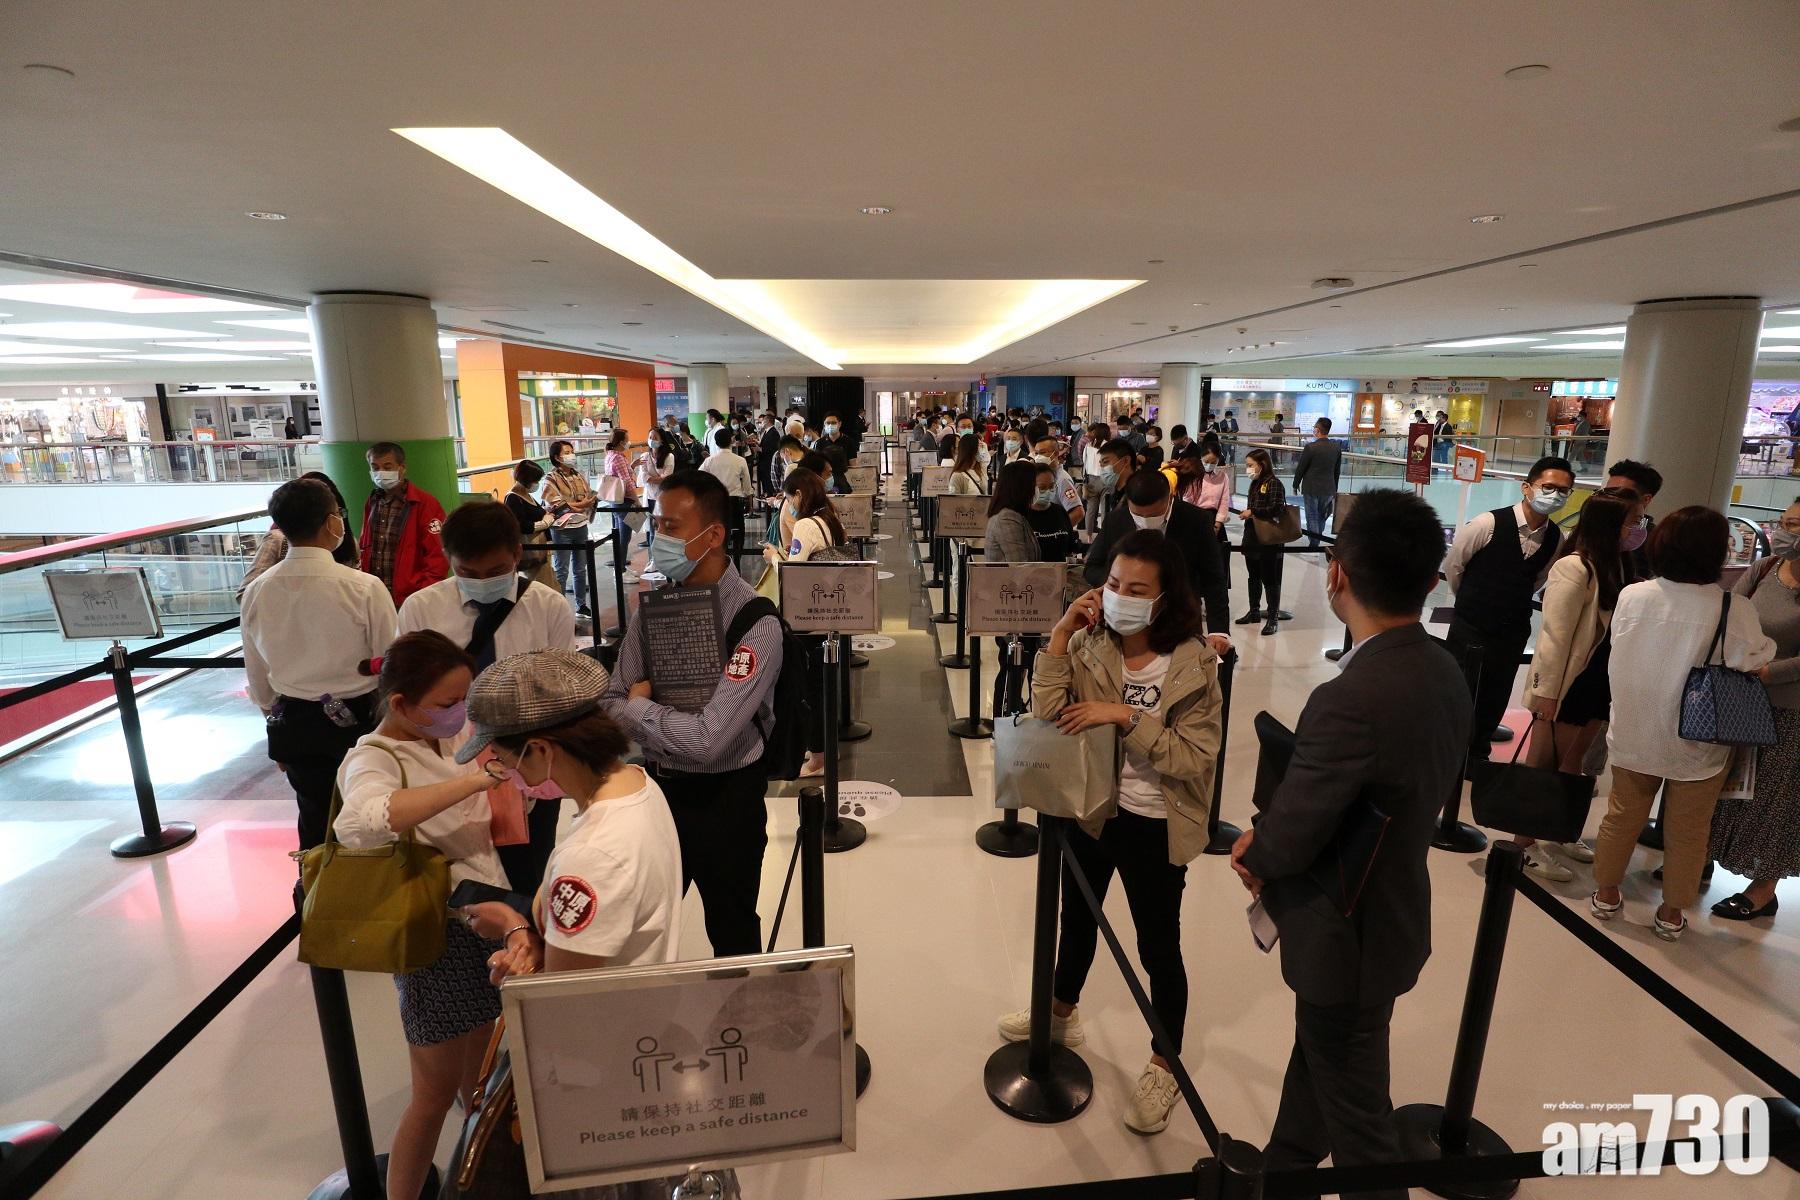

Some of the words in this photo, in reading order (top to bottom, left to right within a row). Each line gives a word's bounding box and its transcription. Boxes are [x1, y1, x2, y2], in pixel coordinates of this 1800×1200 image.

[1306, 381, 1338, 390] KUMON
[728, 663, 749, 676] 地產
[731, 651, 751, 664] 中原
[551, 894, 580, 929] 地產
[559, 882, 592, 913] 中原
[620, 1091, 766, 1123] 請保持社交距離
[580, 1130, 636, 1145] Please
[640, 1124, 681, 1139] keep
[685, 1122, 696, 1132] a
[699, 1115, 735, 1131] safe
[738, 1107, 809, 1127] distance
